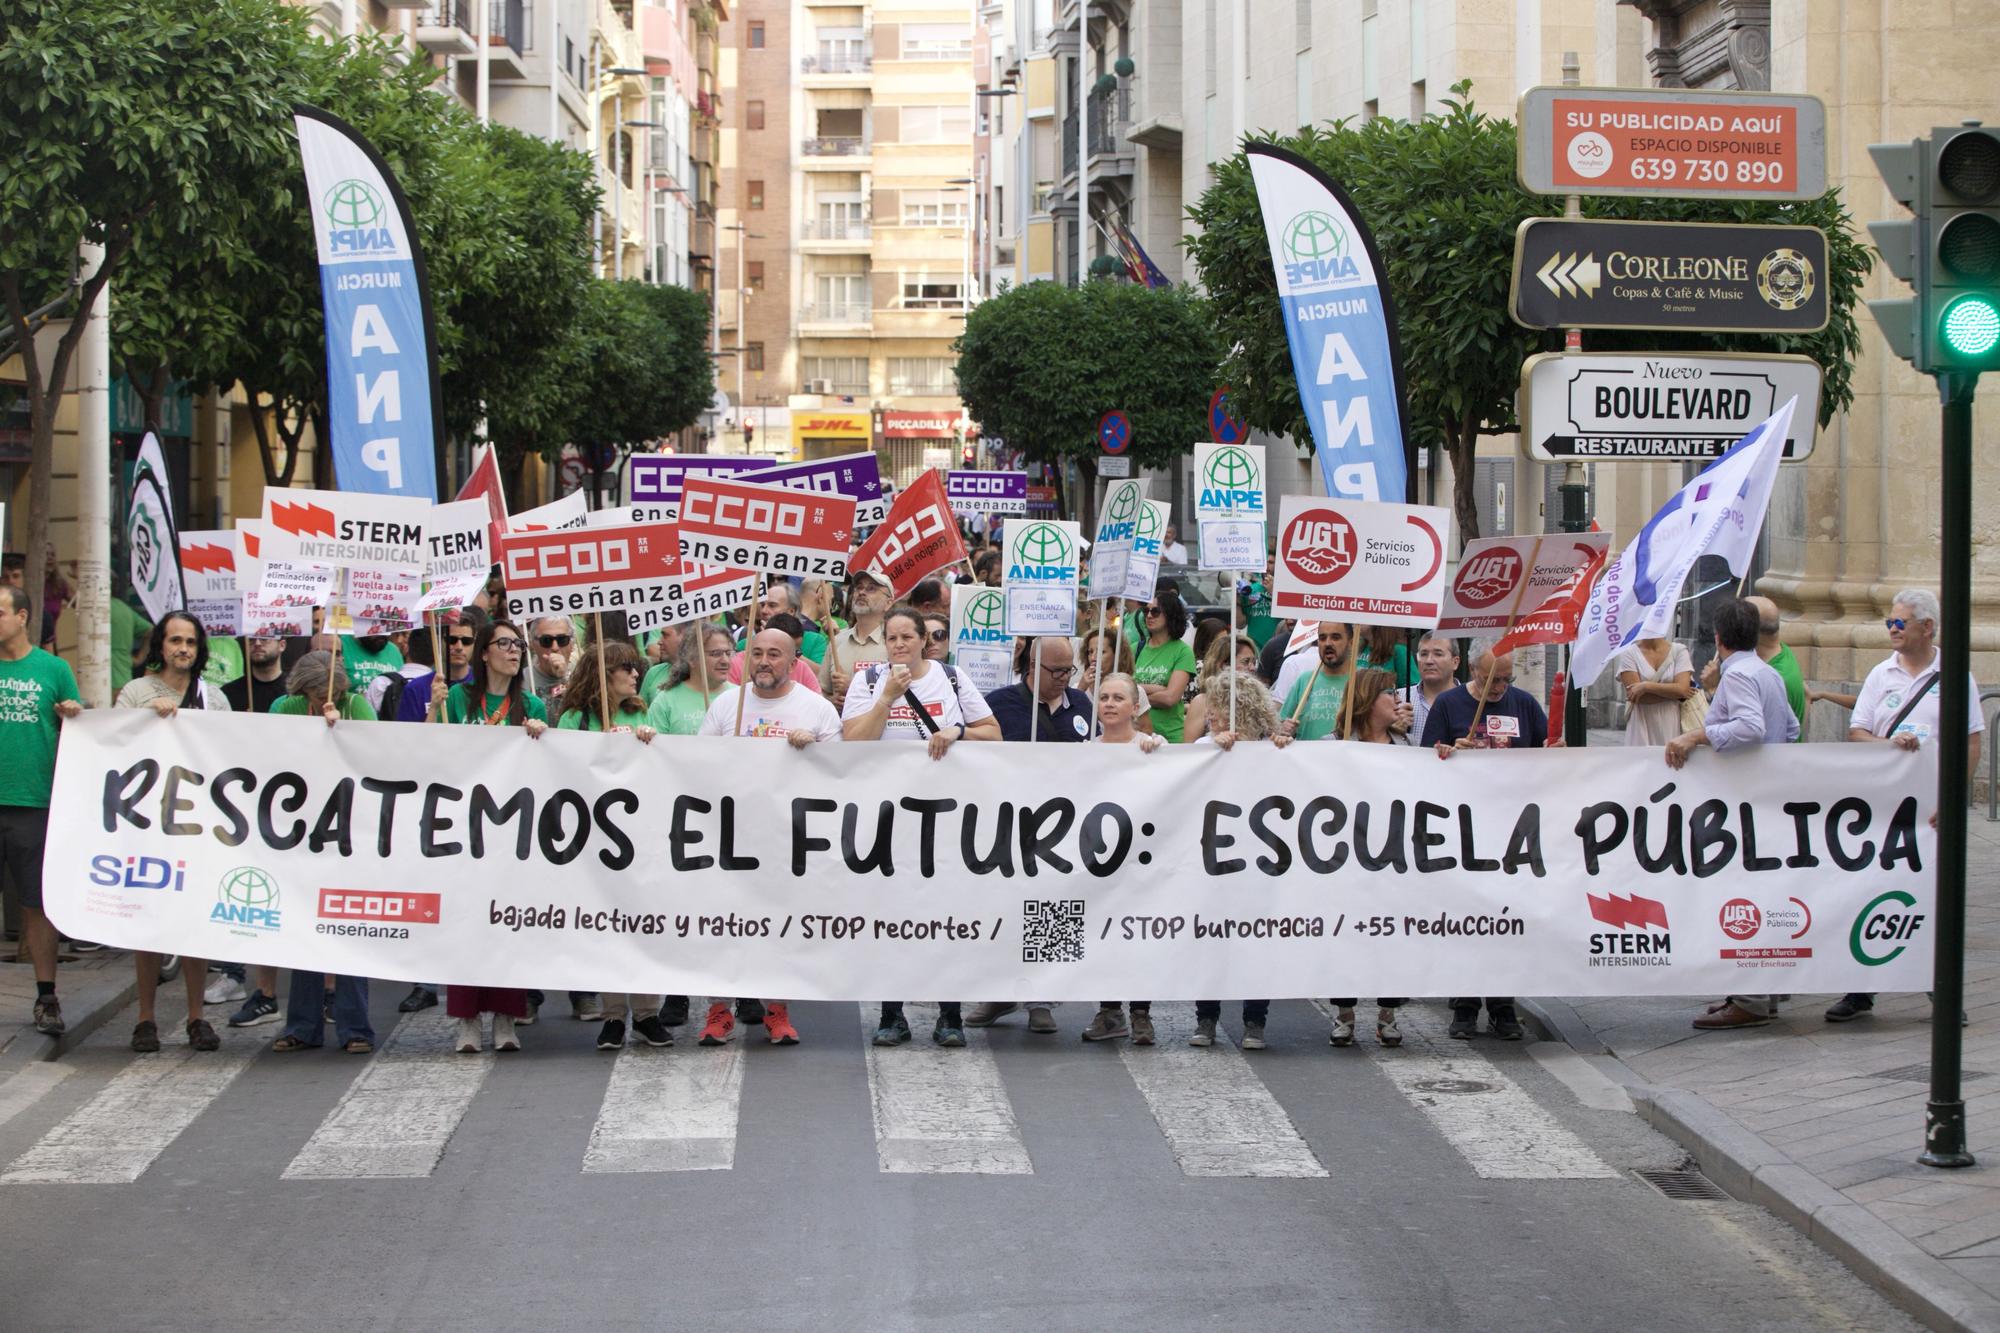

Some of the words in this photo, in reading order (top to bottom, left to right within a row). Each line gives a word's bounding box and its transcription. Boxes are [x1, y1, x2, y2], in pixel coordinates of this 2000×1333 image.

[1566, 112, 1594, 129] SU
[1599, 113, 1725, 133] PUBLICIDAD
[1730, 115, 1783, 134] AQUÍ
[1630, 138, 1693, 152] ESPACIO
[1697, 140, 1783, 155] DISPONIBLE
[1630, 157, 1677, 181] 639
[1684, 159, 1729, 182] 730
[1736, 161, 1784, 184] 890
[1606, 251, 1750, 282] CORLEONE
[1612, 286, 1649, 300] Copas
[1651, 287, 1662, 298] &
[1665, 287, 1692, 299] Café
[1694, 288, 1703, 299] &
[1708, 288, 1744, 299] Music
[1662, 304, 1672, 312] 50
[1642, 362, 1703, 380] Nuevo
[1595, 386, 1752, 420] BOULEVARD
[887, 420, 950, 430] PICCADILLY
[1573, 438, 1715, 456] RESTAURANTE
[950, 478, 1004, 494] CCOO
[949, 500, 1026, 511] enseñanza
[1199, 489, 1264, 509] ANPE
[682, 490, 806, 536] CCOO
[340, 520, 422, 546] STERM
[1097, 521, 1136, 543] ANPE
[1290, 520, 1350, 553] UGT
[299, 541, 421, 565] INTERSINDICAL
[1230, 545, 1249, 554] AÑOS
[1366, 538, 1416, 553] Servicios
[268, 563, 282, 571] por
[284, 563, 293, 571] la
[506, 538, 631, 580] CCOO
[679, 539, 846, 577] enseñanza
[1365, 553, 1411, 567] Públicos
[266, 572, 315, 583] eliminación
[316, 575, 327, 583] de
[353, 570, 371, 580] por
[372, 571, 382, 580] la
[1463, 556, 1518, 581] UGT
[1533, 564, 1575, 576] Servicios
[279, 583, 316, 591] recortes
[352, 581, 383, 590] vuelta
[394, 583, 409, 592] las
[365, 591, 394, 601] horas
[508, 584, 684, 616] enseñanza
[1303, 594, 1345, 610] Región
[1350, 598, 1364, 610] de
[1368, 599, 1412, 614] Murcia
[260, 609, 287, 618] horas
[628, 580, 768, 631] enseñanza
[1020, 603, 1066, 612] ENSEÑANZA
[1460, 616, 1497, 628] Región
[103, 757, 640, 871] RESCATEMOS
[669, 794, 760, 872] EL
[791, 796, 1156, 878] FUTURO:
[1199, 795, 1547, 878] ESCUELA
[1574, 782, 1924, 878] PÚBLICA
[323, 894, 404, 916] CCOO
[1723, 904, 1756, 922] UGT
[1766, 909, 1800, 919] Servicios
[210, 902, 282, 929] ANPE
[489, 899, 566, 932] bajada
[574, 906, 666, 935] lectivas
[675, 914, 690, 938] y
[698, 912, 771, 938] ratios
[780, 914, 793, 939] /
[800, 915, 866, 941] STOP
[873, 916, 981, 941] recortes
[990, 917, 1003, 942] /
[1101, 917, 1113, 942] /
[1120, 915, 1185, 941] STOP
[1193, 913, 1325, 940] burocracia
[1333, 914, 1345, 939] /
[1353, 915, 1396, 938] +55
[1403, 906, 1525, 939] reducción
[1766, 918, 1799, 928] Públicos
[315, 921, 410, 939] enseñanza
[1864, 914, 1926, 940] CSIF
[1589, 933, 1672, 955] STERM
[1588, 955, 1672, 967] INTERSINDICAL
[1735, 949, 1758, 958] Región
[1761, 949, 1770, 957] de
[1772, 949, 1797, 957] Murcia
[1736, 960, 1760, 968] Sector
[1760, 960, 1797, 968] Enseñanza
